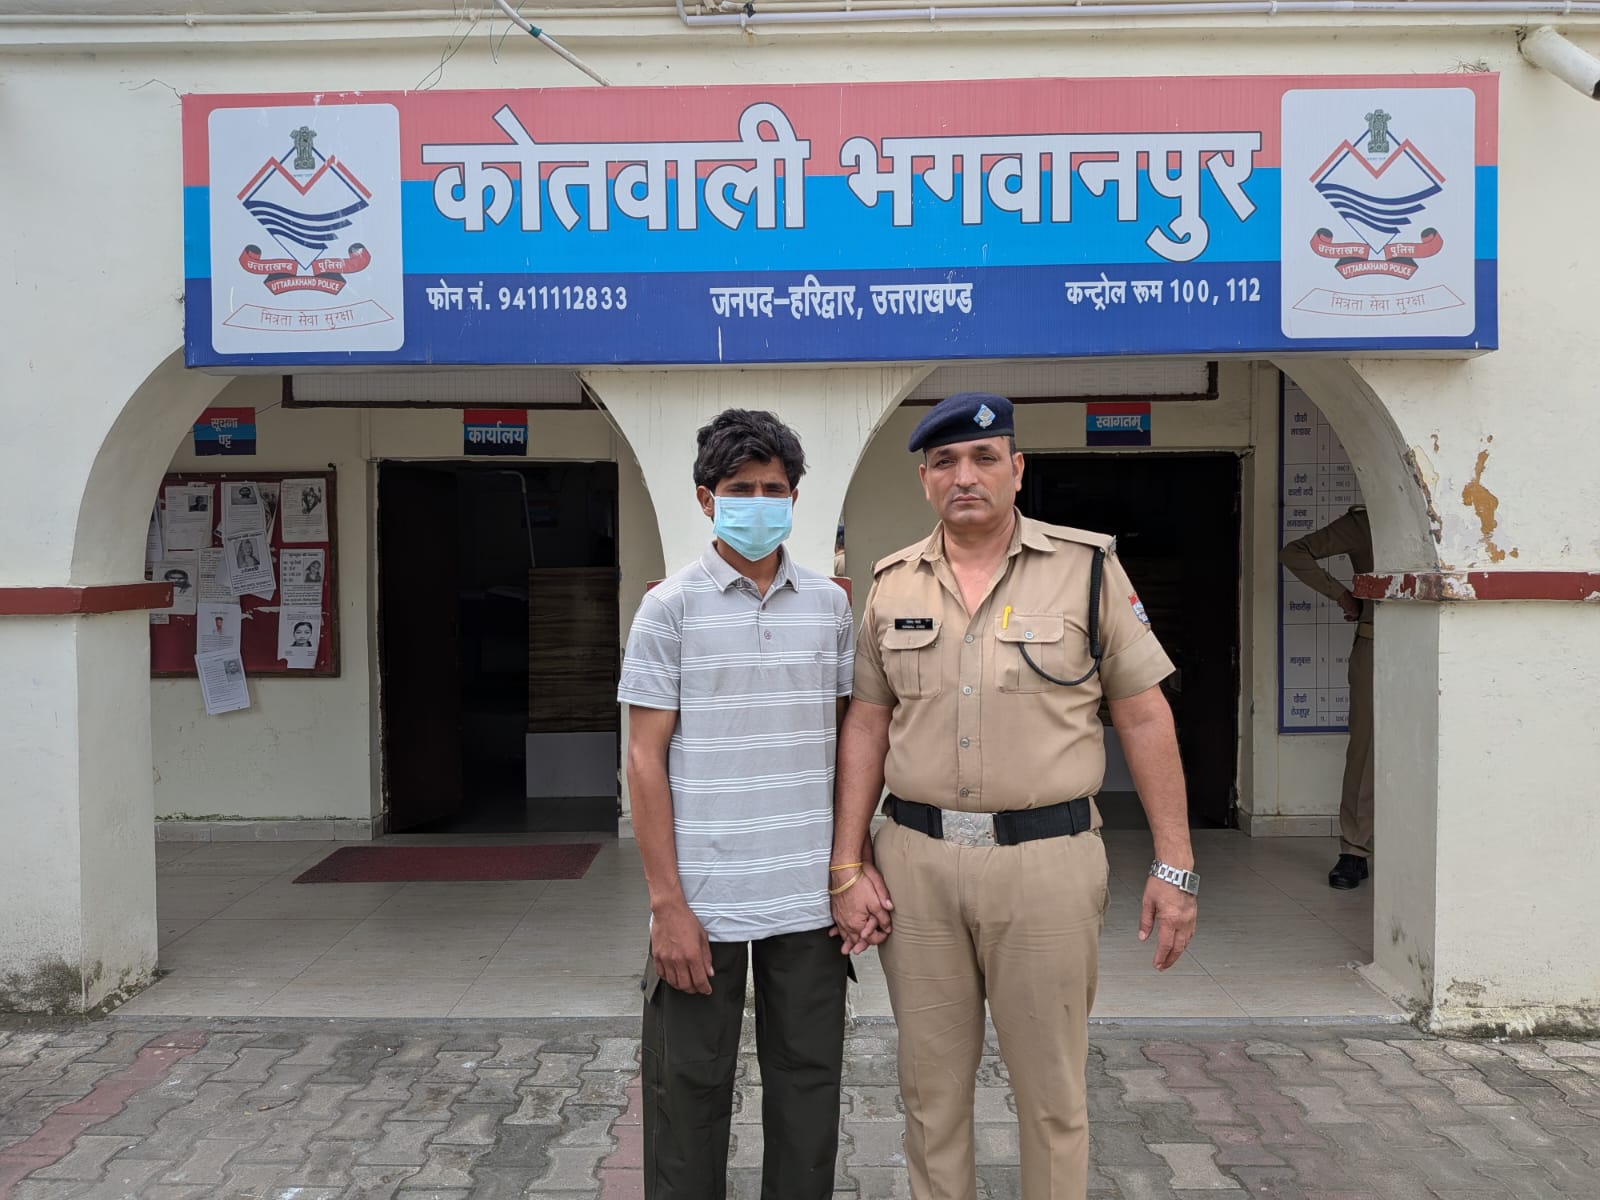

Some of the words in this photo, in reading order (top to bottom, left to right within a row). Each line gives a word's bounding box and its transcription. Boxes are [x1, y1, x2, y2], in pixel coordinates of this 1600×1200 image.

[421, 102, 811, 232] कोतवाली
[840, 131, 1262, 263] भगवानपुर
[1389, 243, 1415, 257] पुलिस
[318, 259, 343, 273] पुलिस
[1342, 262, 1388, 275] UTTARAKHAND
[1389, 263, 1412, 276] POLICE
[271, 279, 317, 291] UTTARAKHAND
[317, 279, 340, 292] POLICE
[426, 278, 463, 310] फोन
[467, 281, 491, 310] नं.
[498, 286, 627, 310] 9411112833
[1065, 272, 1127, 311] कन्ट्रोल
[1131, 280, 1163, 303] रूम
[1226, 277, 1261, 302] 112
[869, 282, 974, 315] उत्तराखण्ड
[1331, 292, 1363, 311] मित्रता
[1369, 295, 1389, 311] सेवा
[1396, 294, 1425, 314] सुरक्षा
[260, 310, 293, 327] मित्रता
[298, 311, 318, 326] सेवा
[325, 309, 354, 329] सुरक्षा
[211, 417, 239, 432] सूचना
[467, 420, 525, 444] कार्यालय
[1095, 415, 1144, 432] स्वागतम्
